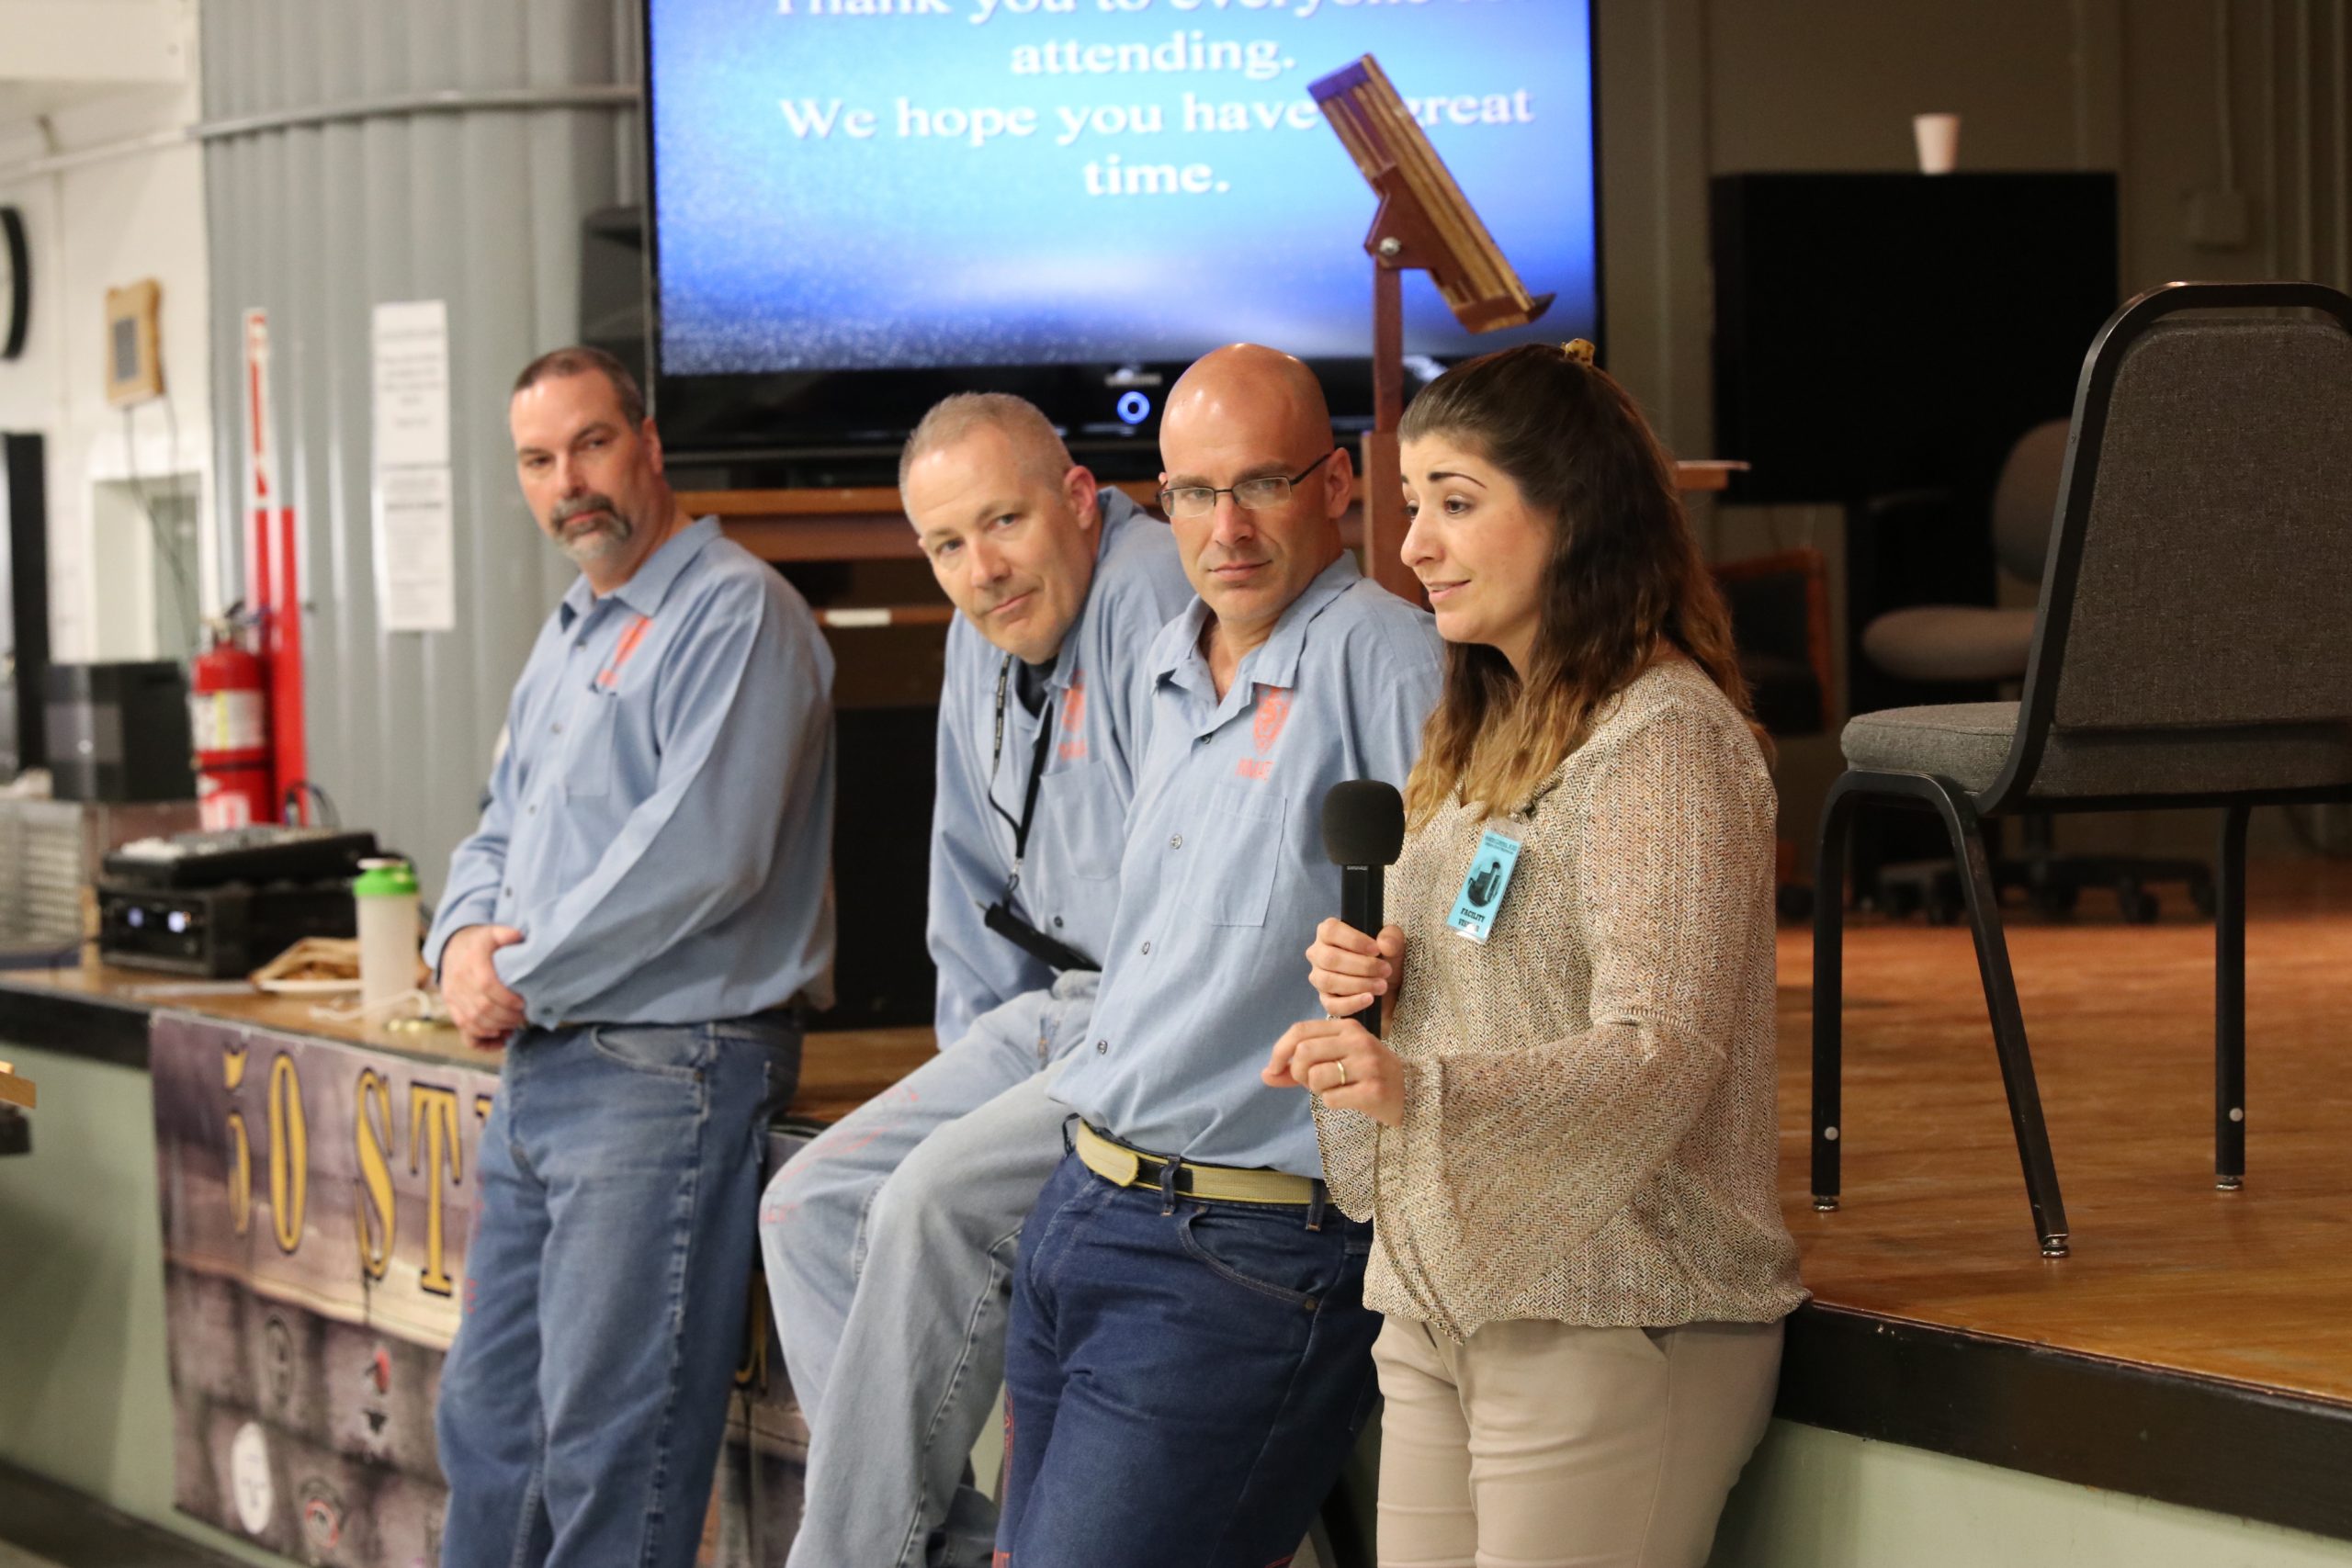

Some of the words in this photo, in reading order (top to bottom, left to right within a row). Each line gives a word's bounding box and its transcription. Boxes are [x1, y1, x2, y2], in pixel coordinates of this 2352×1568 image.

[1011, 29, 1295, 80] attending.
[779, 98, 877, 138] We
[896, 96, 1038, 147] hope
[1057, 103, 1163, 145] you
[1182, 92, 1319, 131] have
[1084, 152, 1230, 195] time.
[1461, 908, 1486, 922] FACILITY
